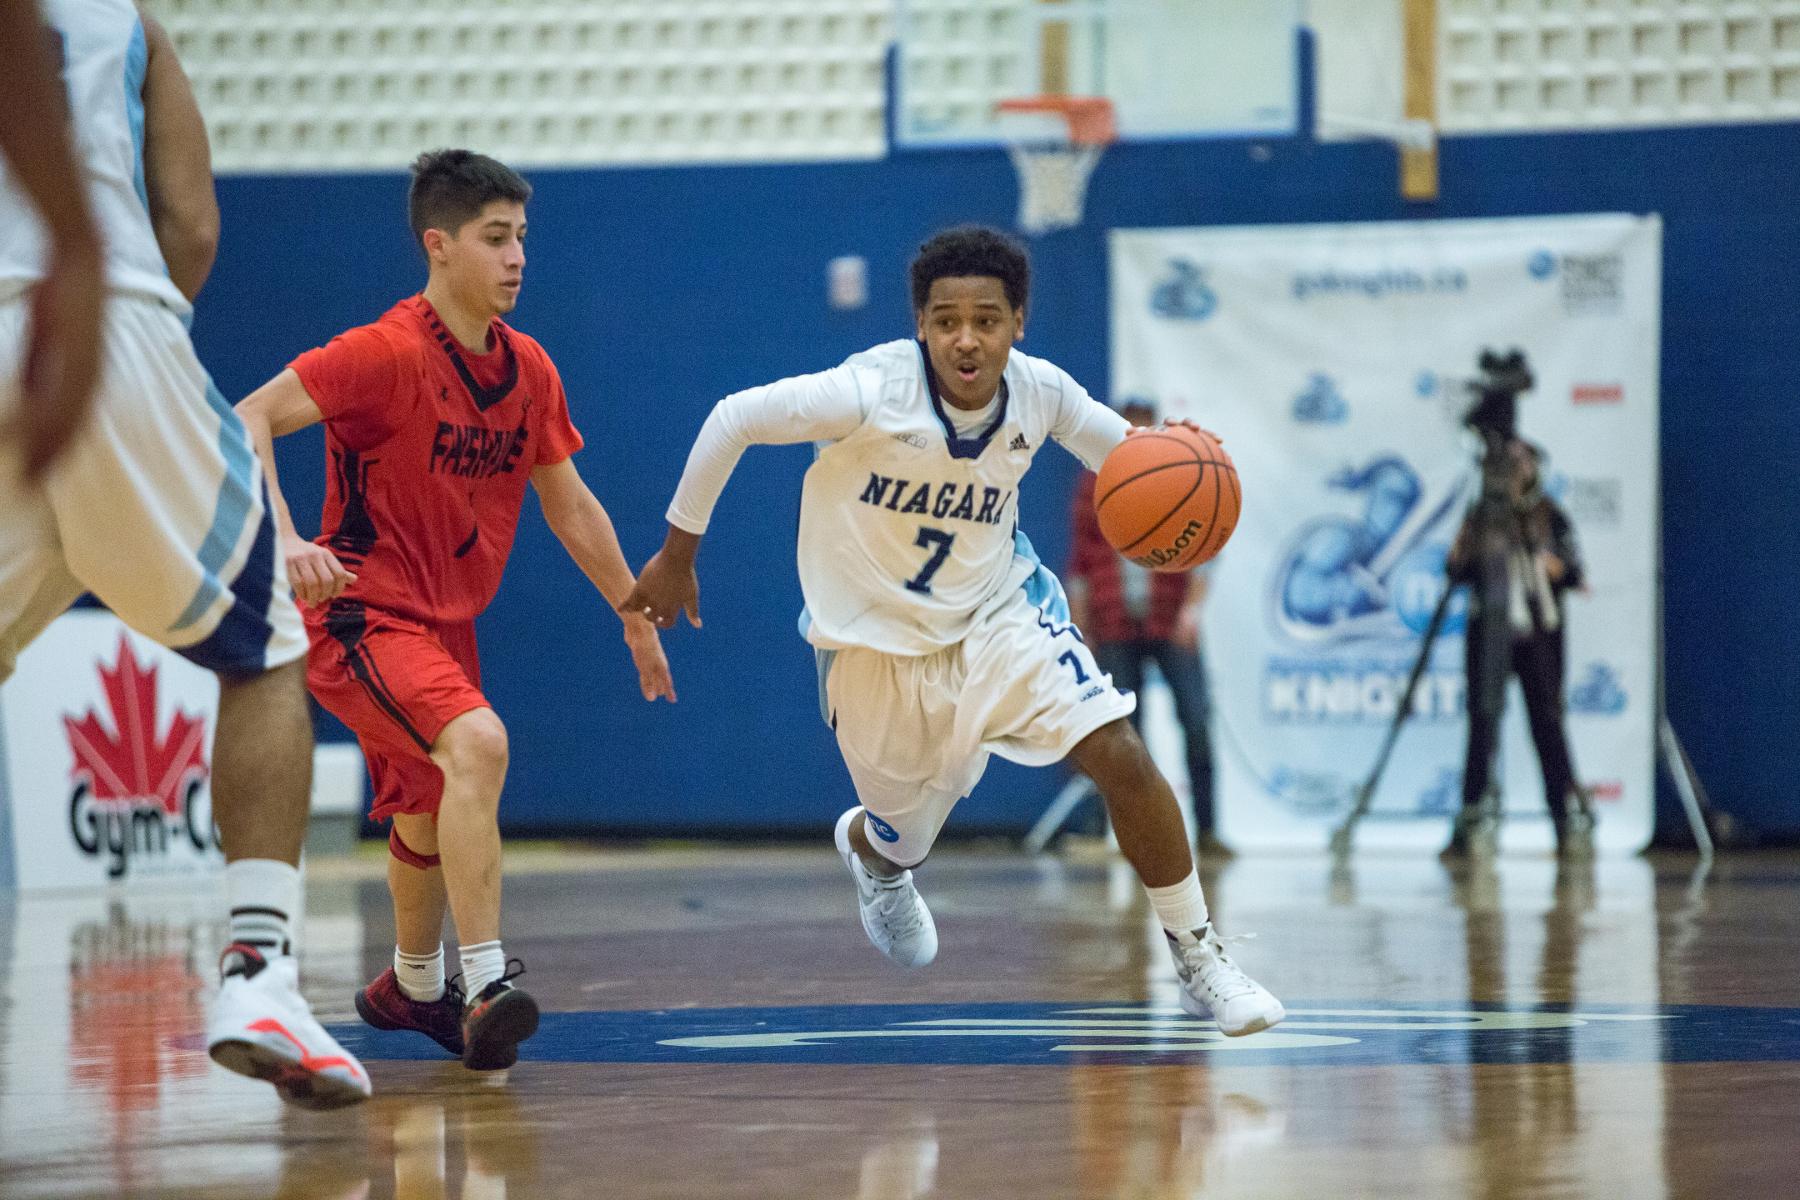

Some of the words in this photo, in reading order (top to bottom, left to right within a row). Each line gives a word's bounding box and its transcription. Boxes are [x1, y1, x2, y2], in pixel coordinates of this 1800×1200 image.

[905, 526, 956, 595] 7
[1058, 649, 1090, 685] 7
[71, 779, 220, 876] Gym-C
